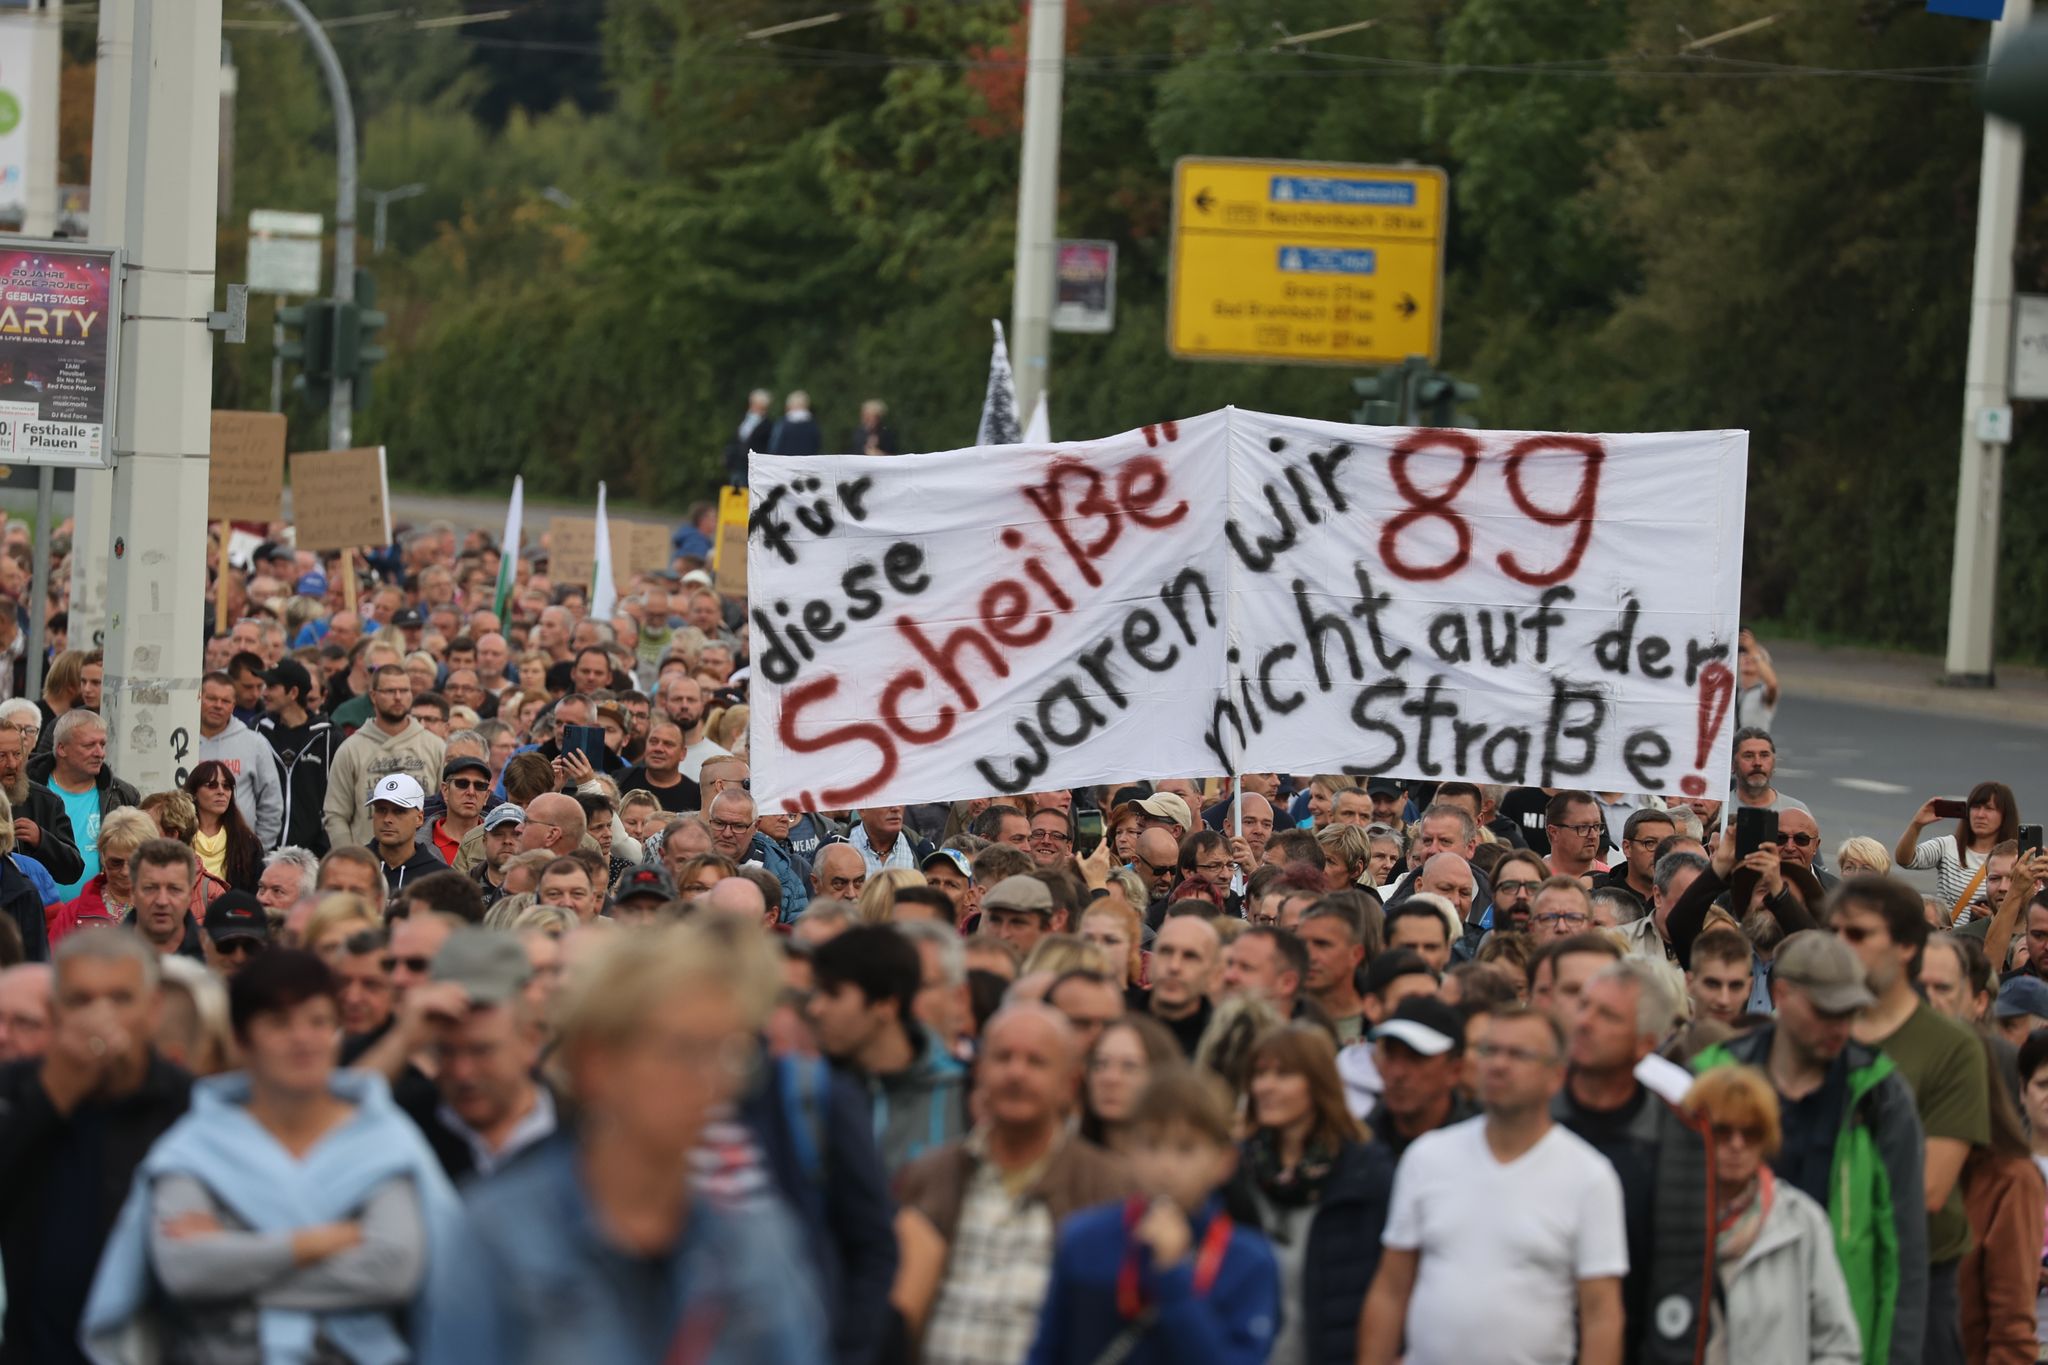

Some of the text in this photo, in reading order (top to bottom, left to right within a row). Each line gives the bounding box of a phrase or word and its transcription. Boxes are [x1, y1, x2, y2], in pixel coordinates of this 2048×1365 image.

[12, 269, 65, 279] 20 JAHRE
[12, 279, 38, 287] FACE
[40, 280, 91, 290] PROJECT
[5, 290, 89, 305] GEBURTSTAGS-
[0, 305, 99, 338] ARTY
[0, 421, 12, 436] 0.
[23, 422, 87, 438] Festhalle
[30, 435, 78, 449] Plauen
[751, 541, 932, 685] diese
[974, 427, 1607, 795] waren wir 89
[1204, 560, 1729, 778] nicht auf der
